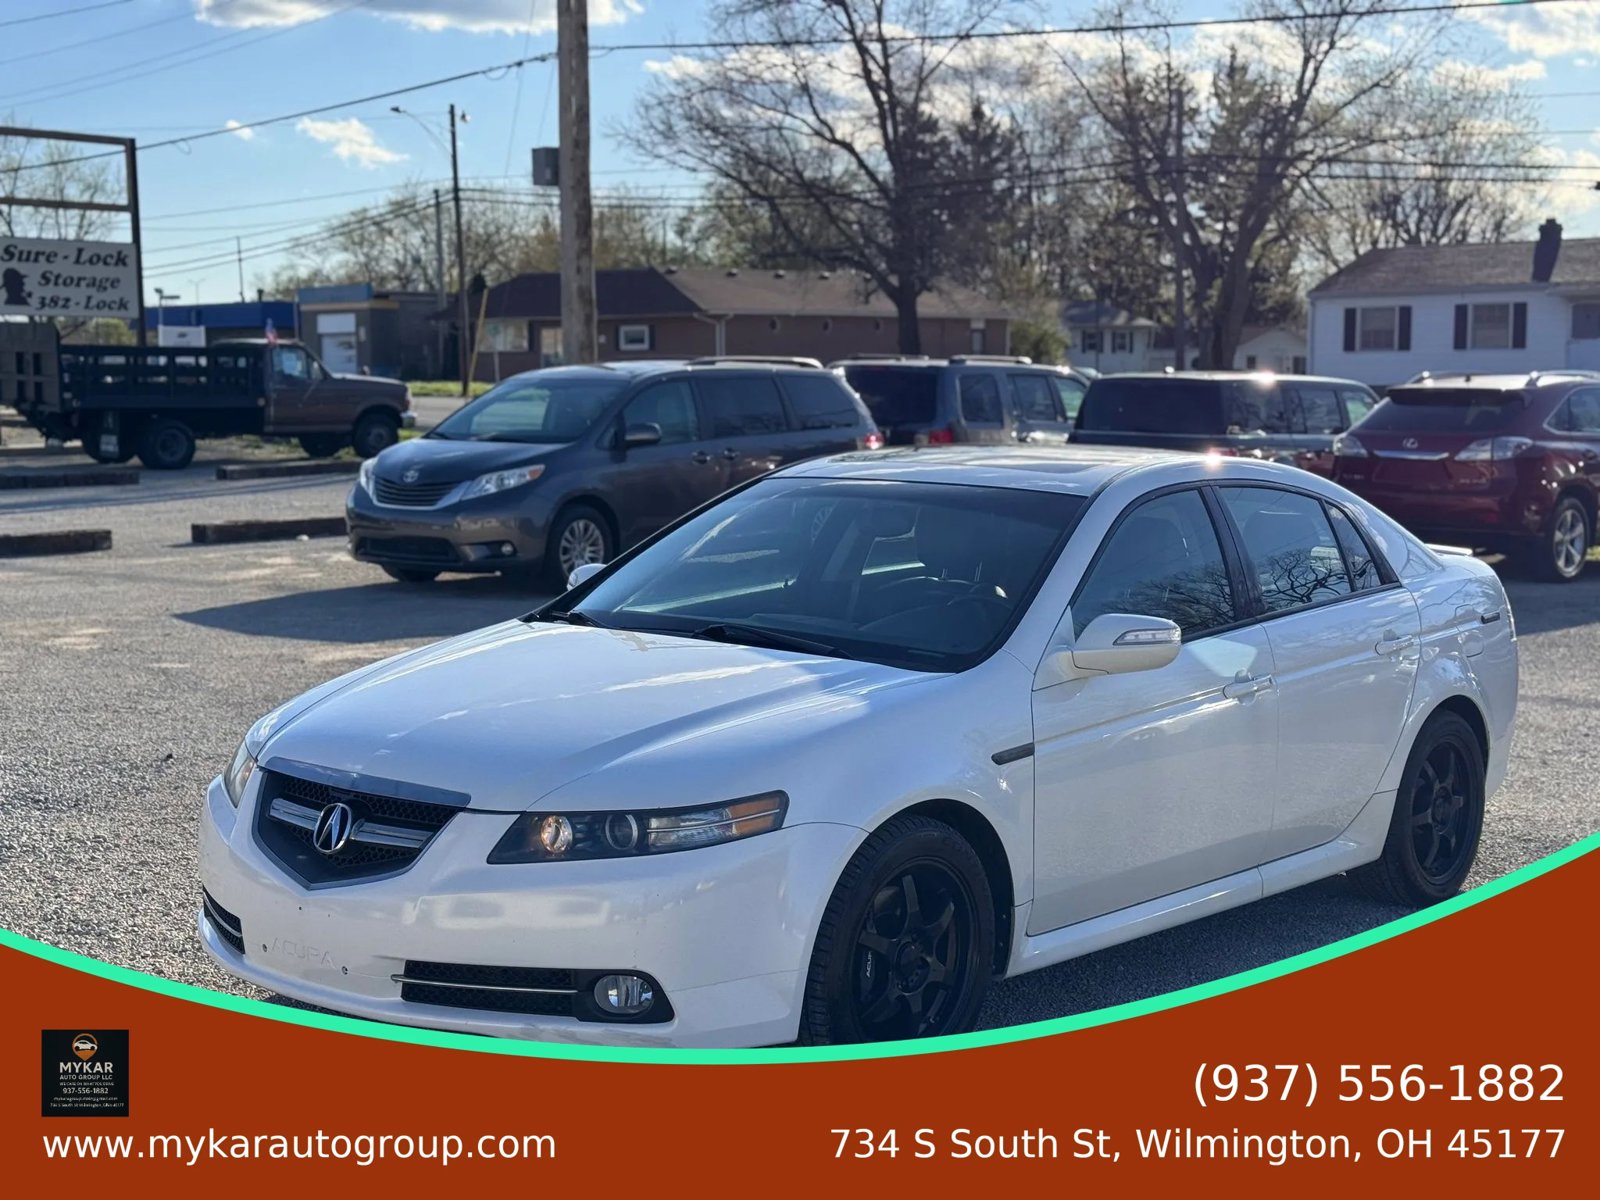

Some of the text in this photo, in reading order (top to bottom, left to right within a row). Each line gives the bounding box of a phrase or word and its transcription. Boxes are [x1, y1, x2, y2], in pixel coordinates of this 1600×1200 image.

[1, 244, 58, 264] Sure
[73, 247, 129, 268] Lock
[38, 270, 121, 293] Storage
